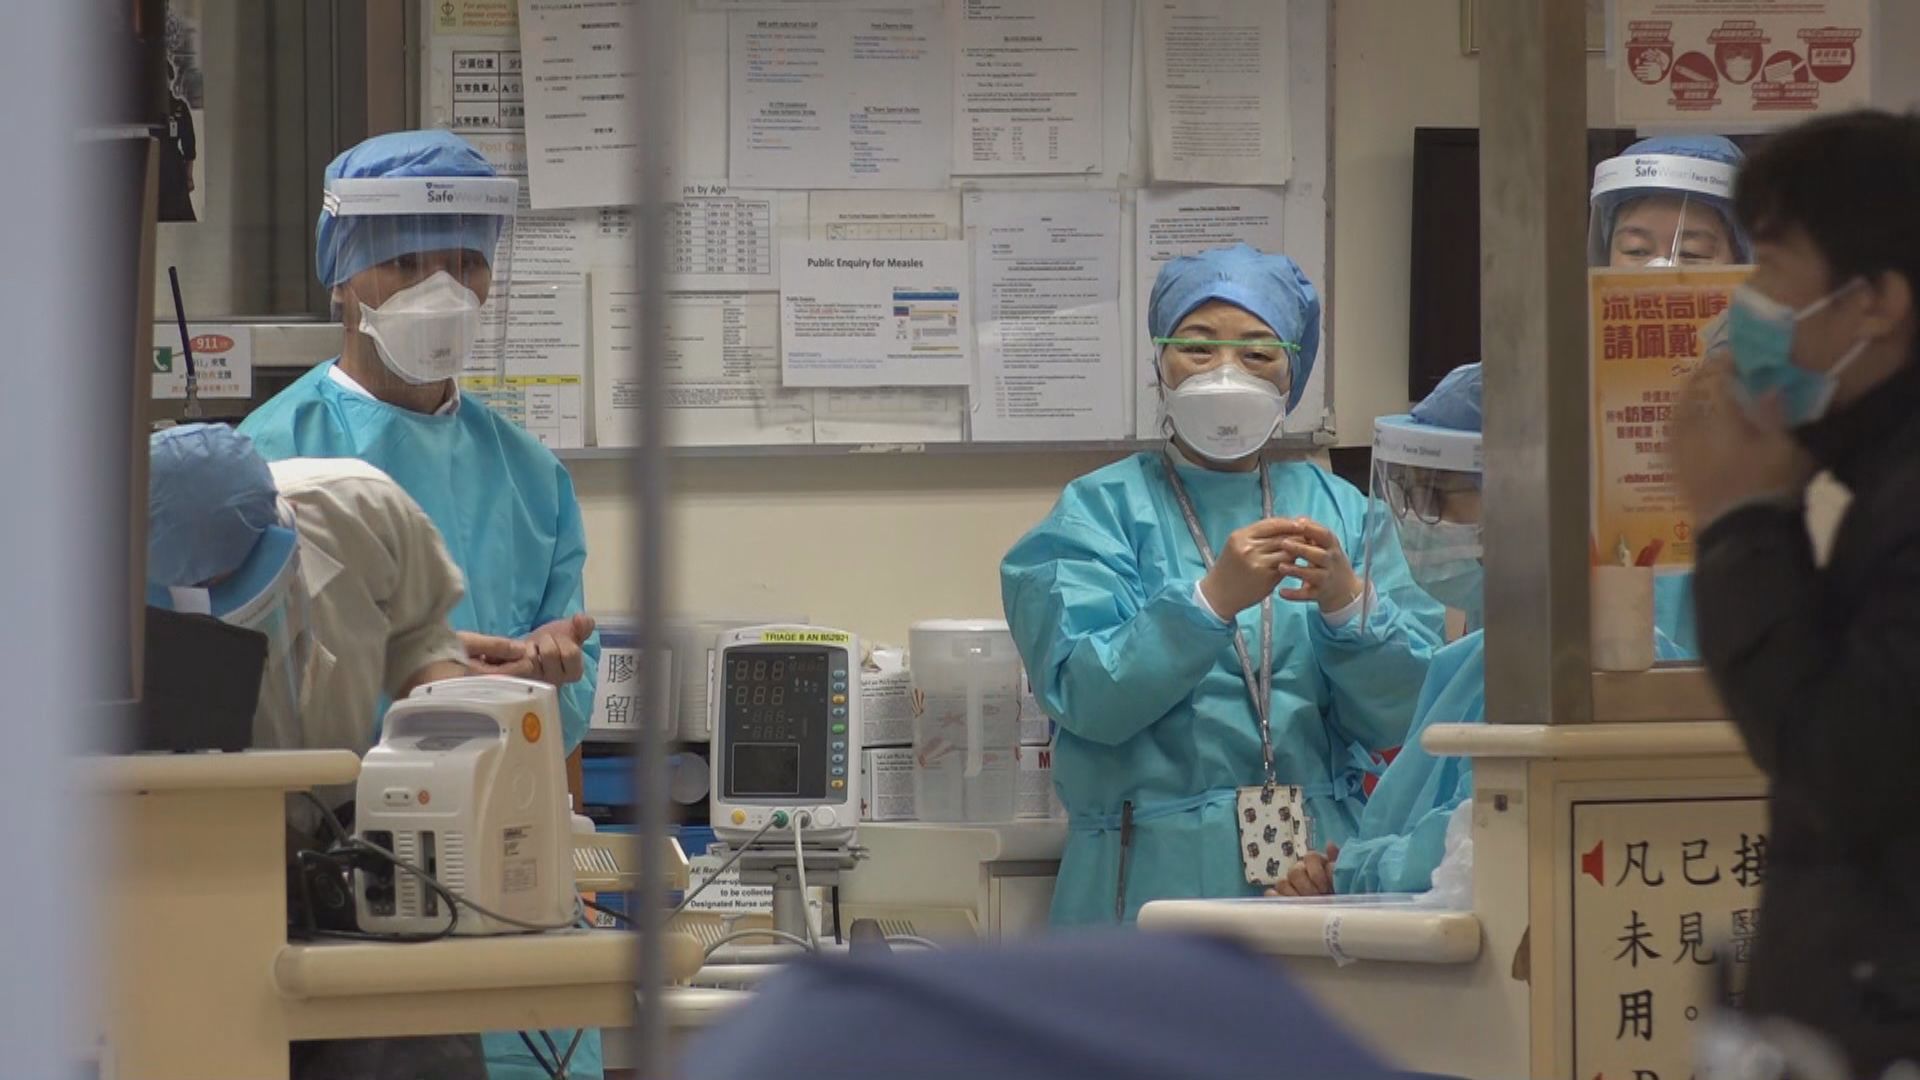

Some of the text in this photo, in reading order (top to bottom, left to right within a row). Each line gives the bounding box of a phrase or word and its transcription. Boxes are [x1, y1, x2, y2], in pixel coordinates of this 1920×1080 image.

[711, 185, 727, 195] Age
[808, 258, 924, 269] Public Enquiry for Measles
[195, 337, 218, 350] 911
[1603, 324, 1698, 360] 請佩戴
[765, 632, 796, 641] TRIAGE
[806, 632, 818, 641] AN
[608, 654, 641, 683] 膠
[720, 889, 729, 897] to
[730, 889, 740, 897] be
[691, 900, 733, 909] Designated
[735, 900, 757, 908] Nurse
